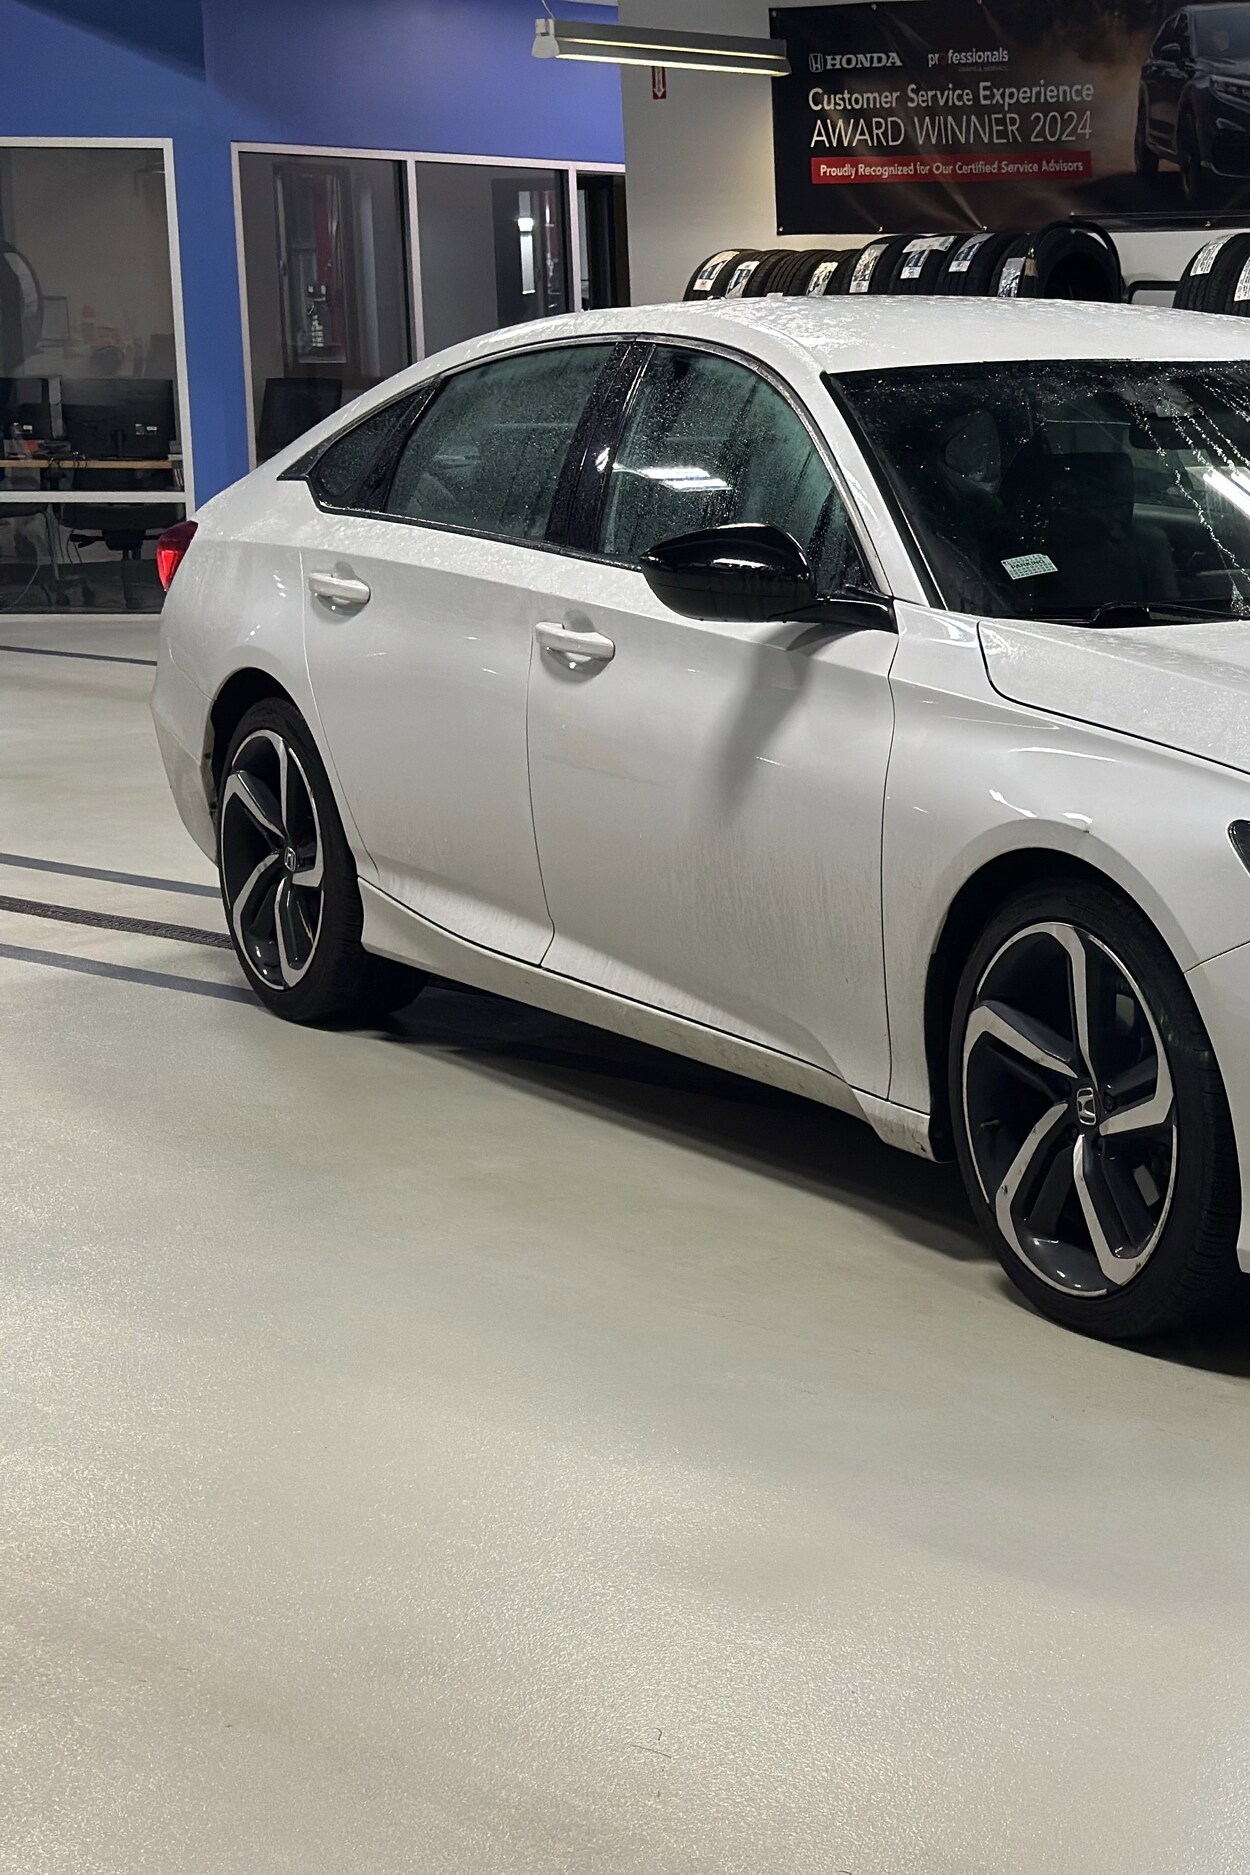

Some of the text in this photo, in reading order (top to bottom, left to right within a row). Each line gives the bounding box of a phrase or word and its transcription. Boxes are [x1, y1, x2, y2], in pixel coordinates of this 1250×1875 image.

[825, 52, 903, 70] HONDA
[808, 79, 1094, 111] Customer Service Experience
[810, 111, 1093, 147] AWARD WINNER 2024
[820, 159, 1084, 179] Proudly Recognized for Our Certified Service Advisors
